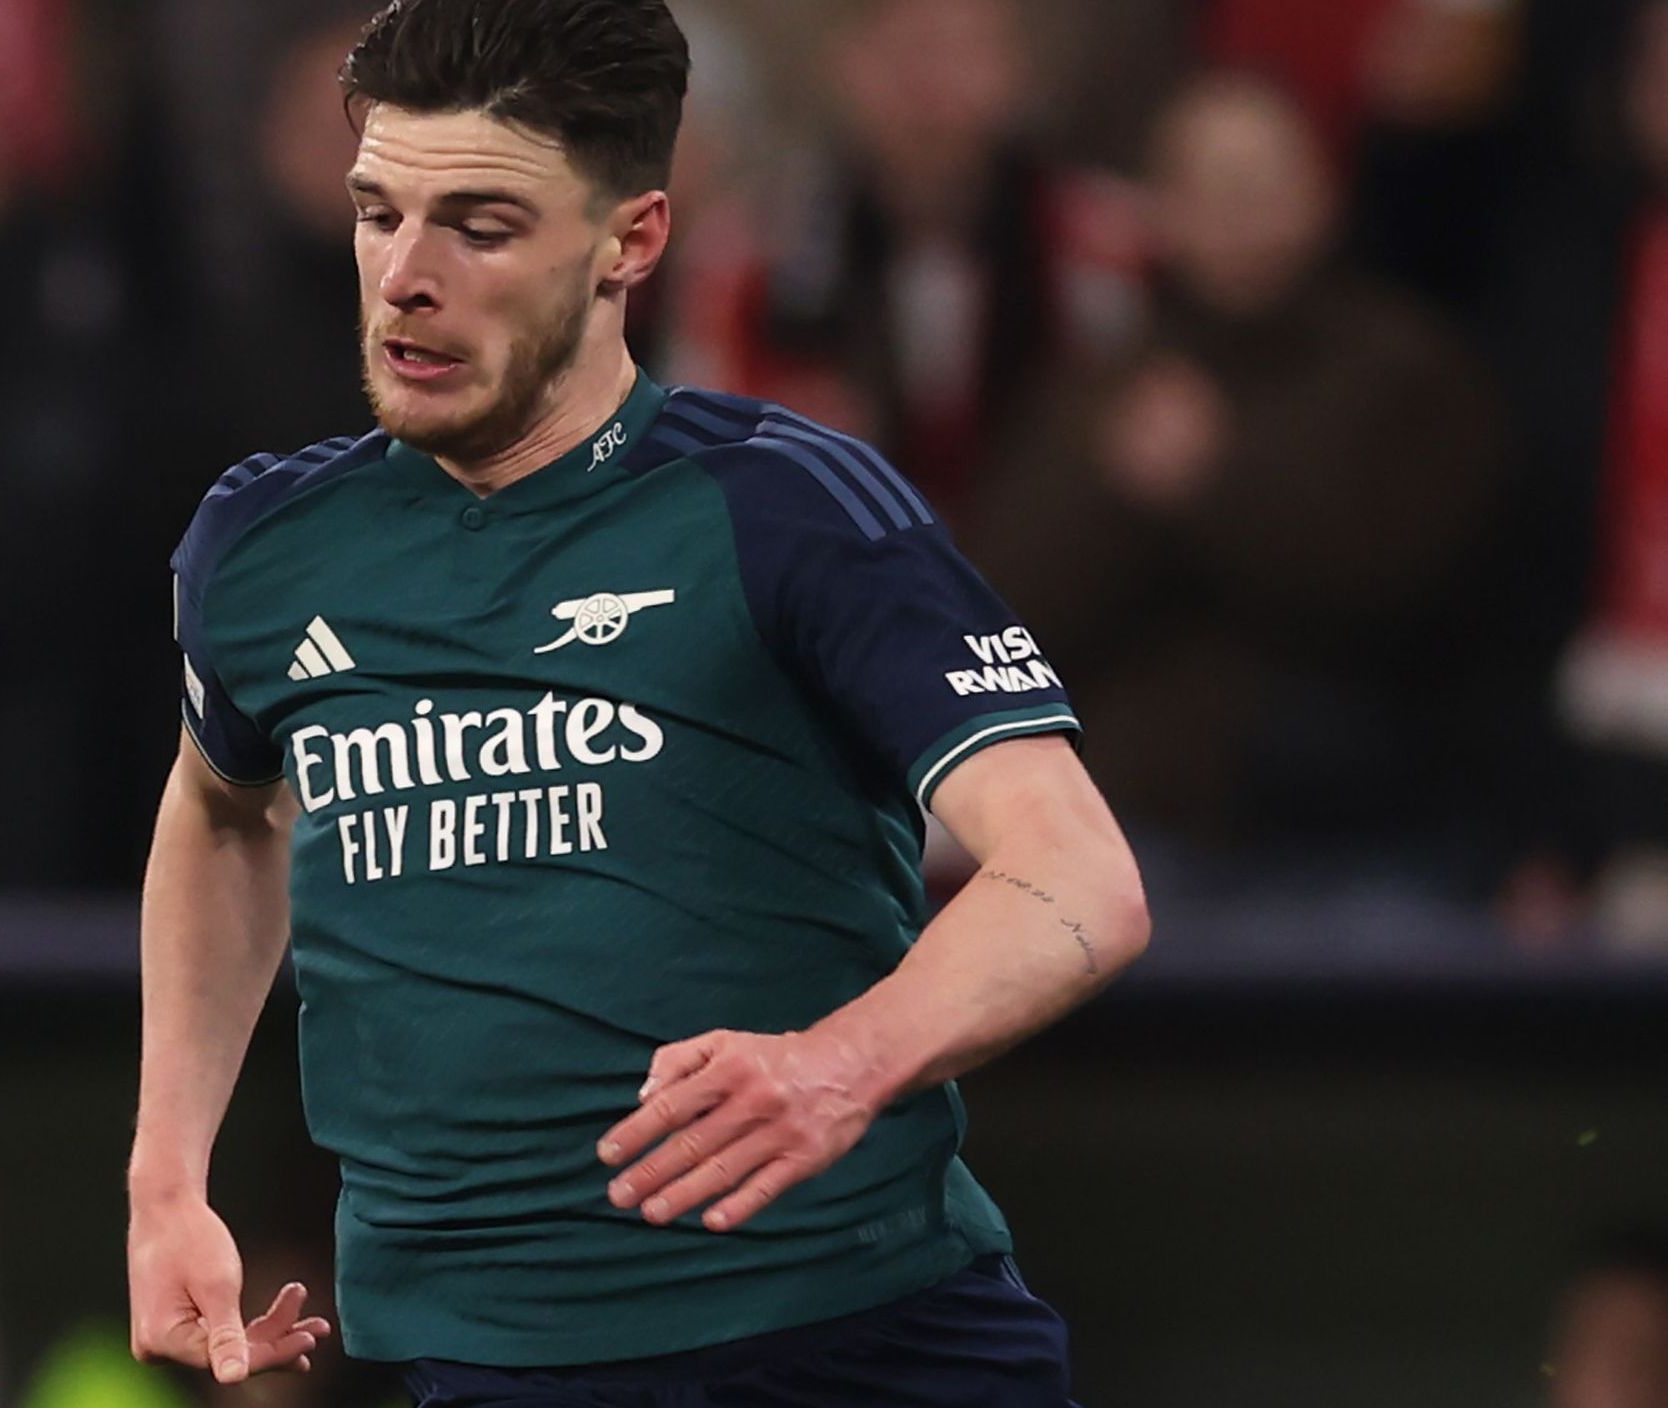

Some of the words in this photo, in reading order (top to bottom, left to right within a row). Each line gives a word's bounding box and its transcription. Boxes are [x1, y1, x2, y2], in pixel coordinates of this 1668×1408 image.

[945, 659, 1064, 696] RWAN
[291, 690, 664, 813] Emirates
[338, 805, 408, 884] FLY
[429, 782, 608, 872] BETTER
